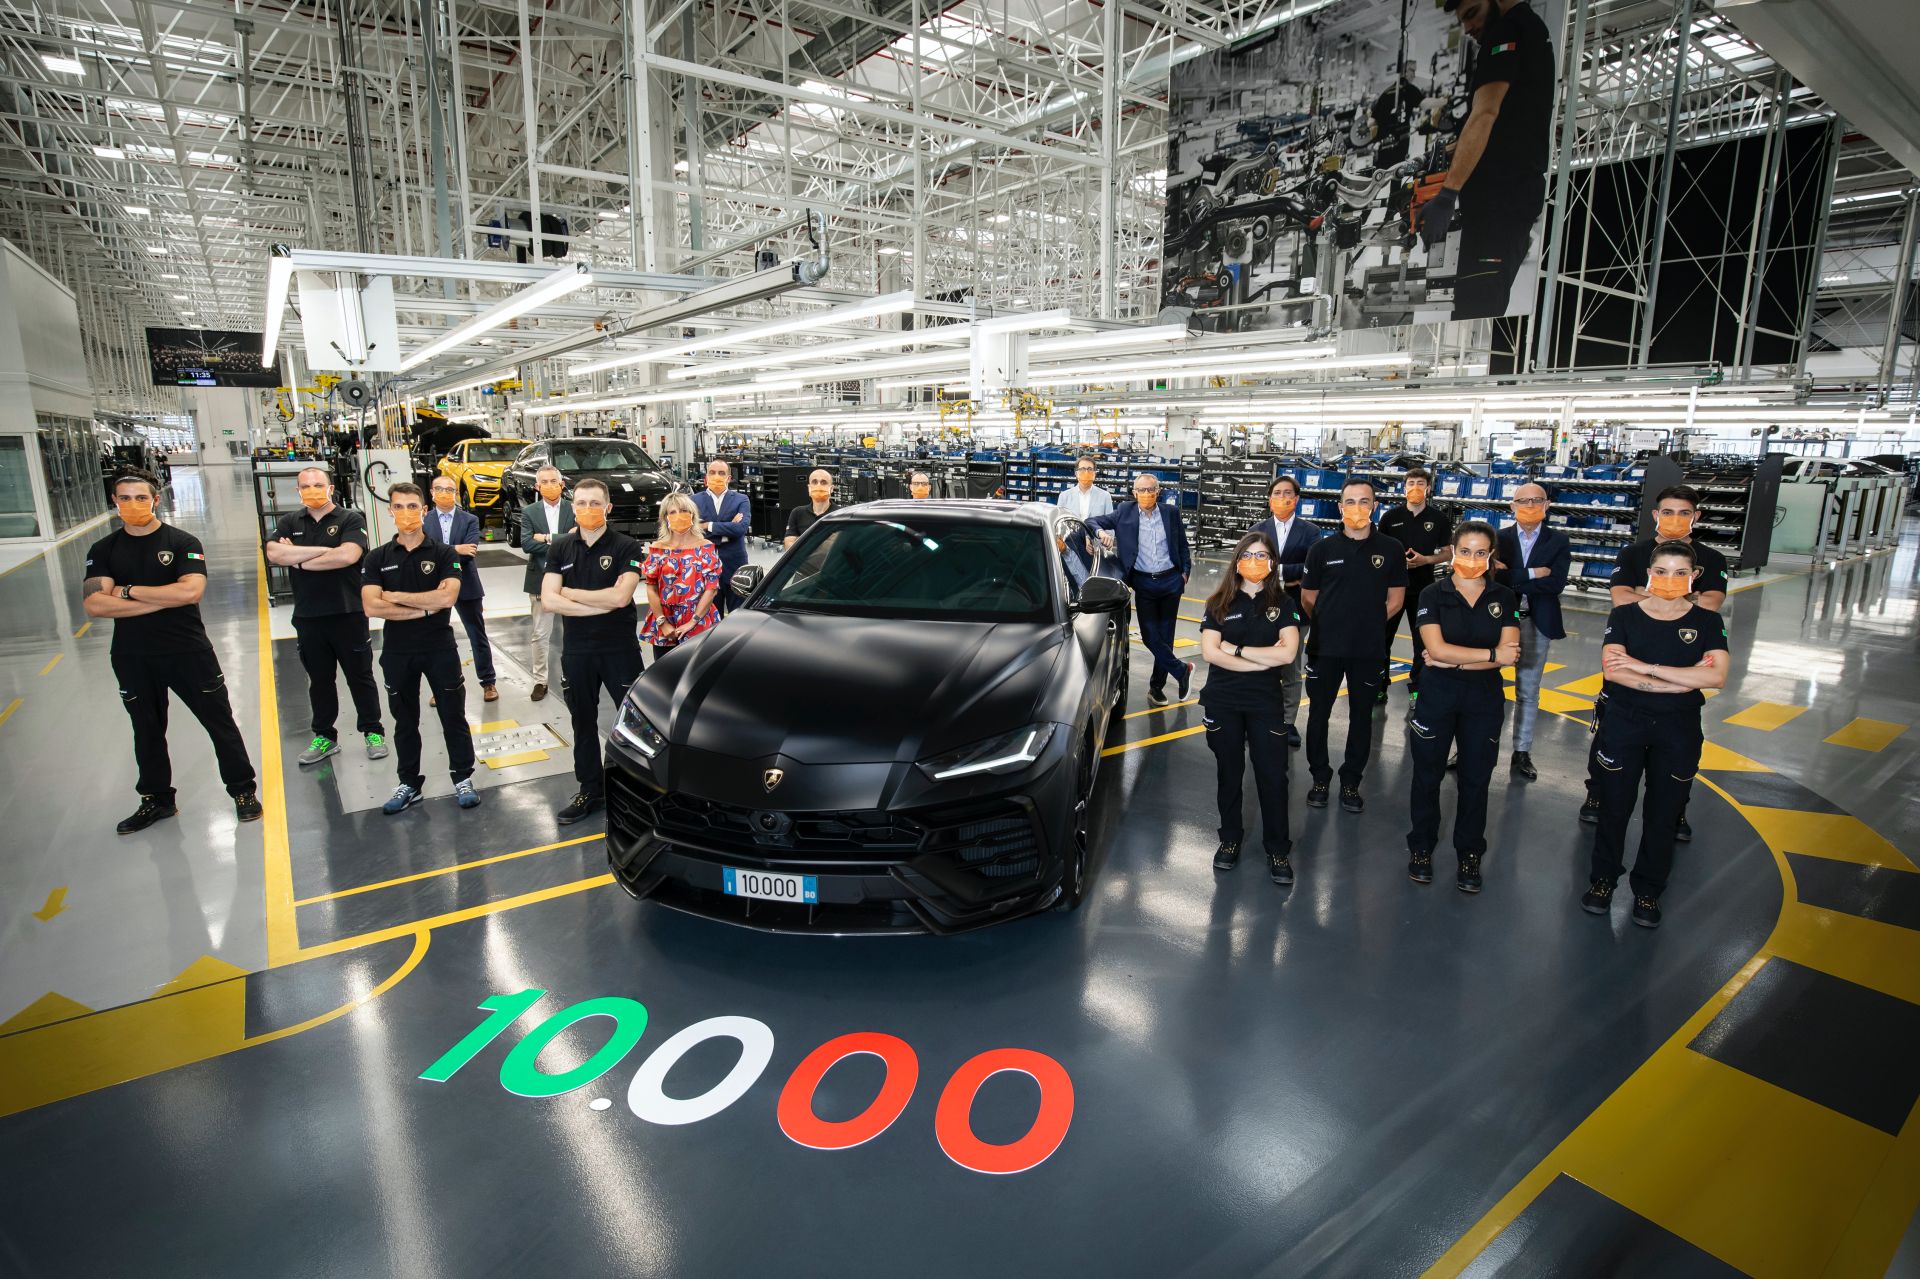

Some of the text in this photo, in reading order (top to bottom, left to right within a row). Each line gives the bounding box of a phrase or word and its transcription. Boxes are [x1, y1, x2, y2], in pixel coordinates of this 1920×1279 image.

[727, 874, 816, 899] I 10.000 BO
[418, 988, 1075, 1175] 10.000
